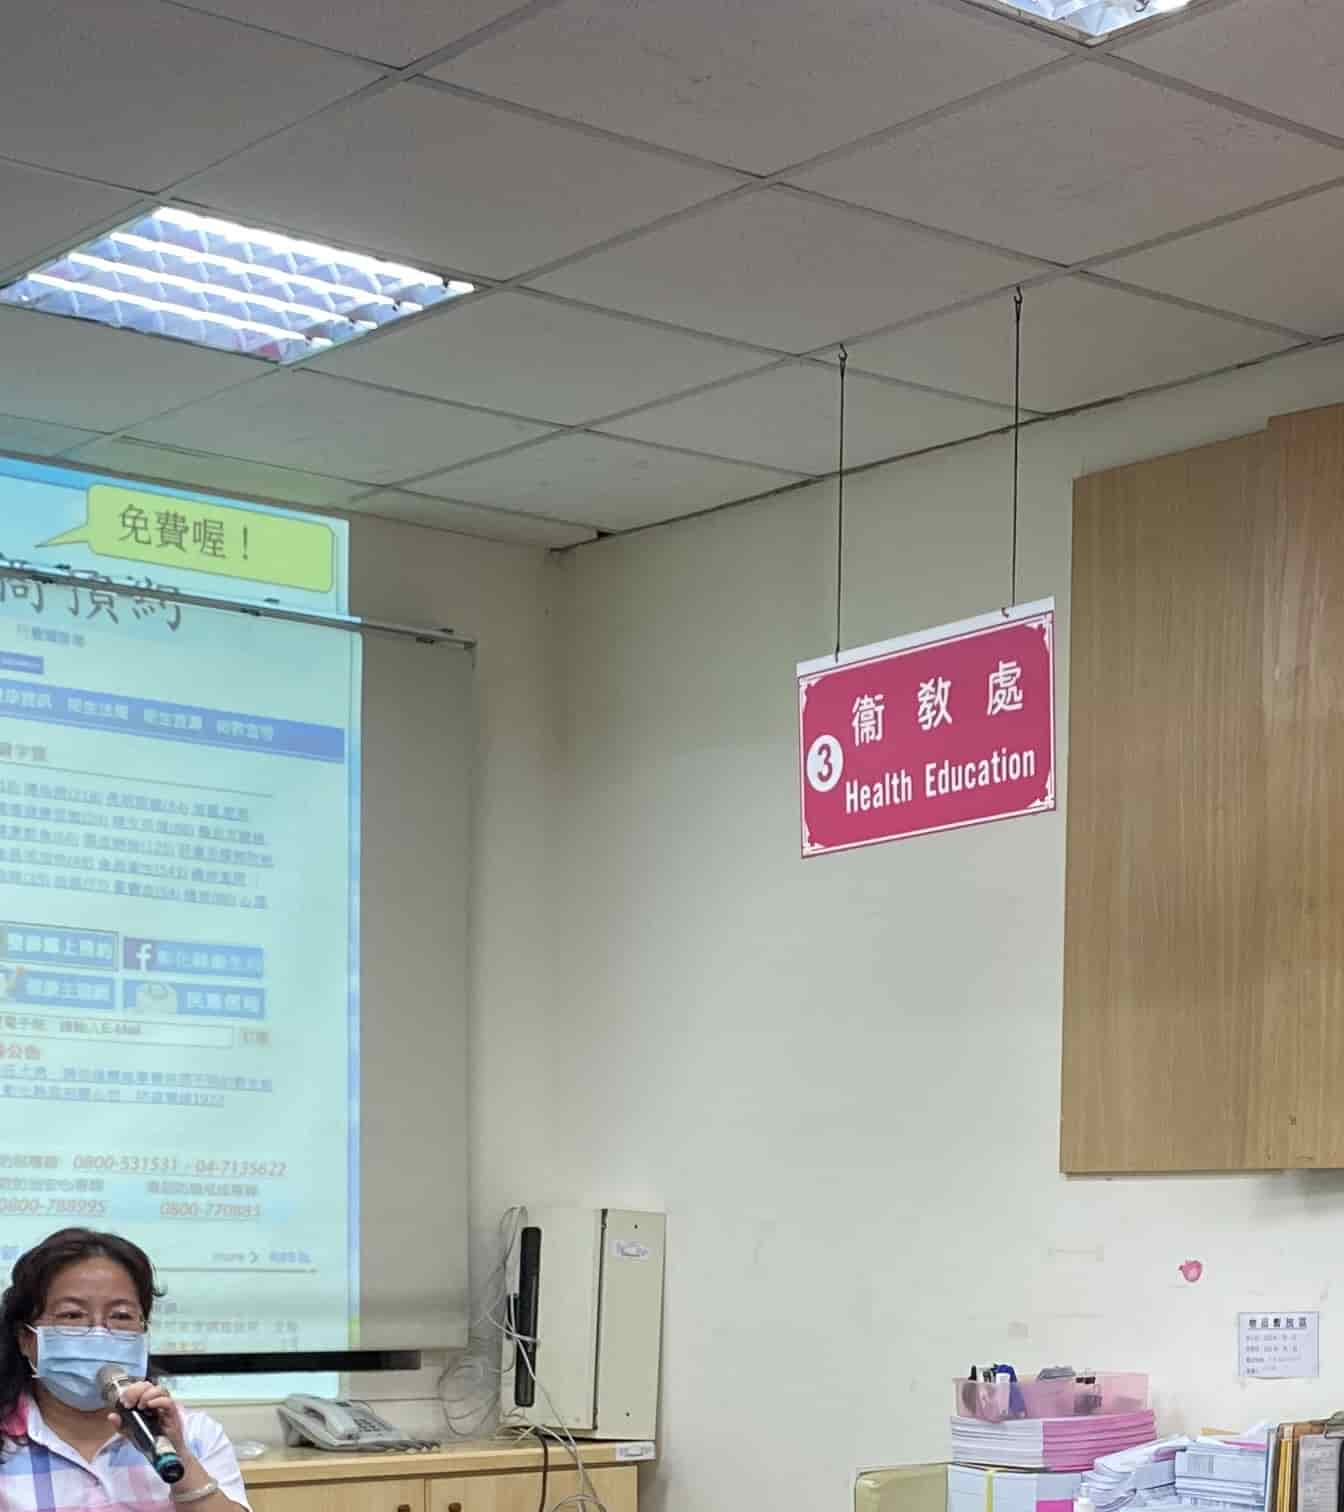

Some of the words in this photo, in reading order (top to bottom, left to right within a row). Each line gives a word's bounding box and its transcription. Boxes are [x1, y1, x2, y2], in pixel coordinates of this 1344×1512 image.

[816, 743, 833, 783] 3
[845, 770, 913, 814] Health
[925, 747, 1036, 797] Education
